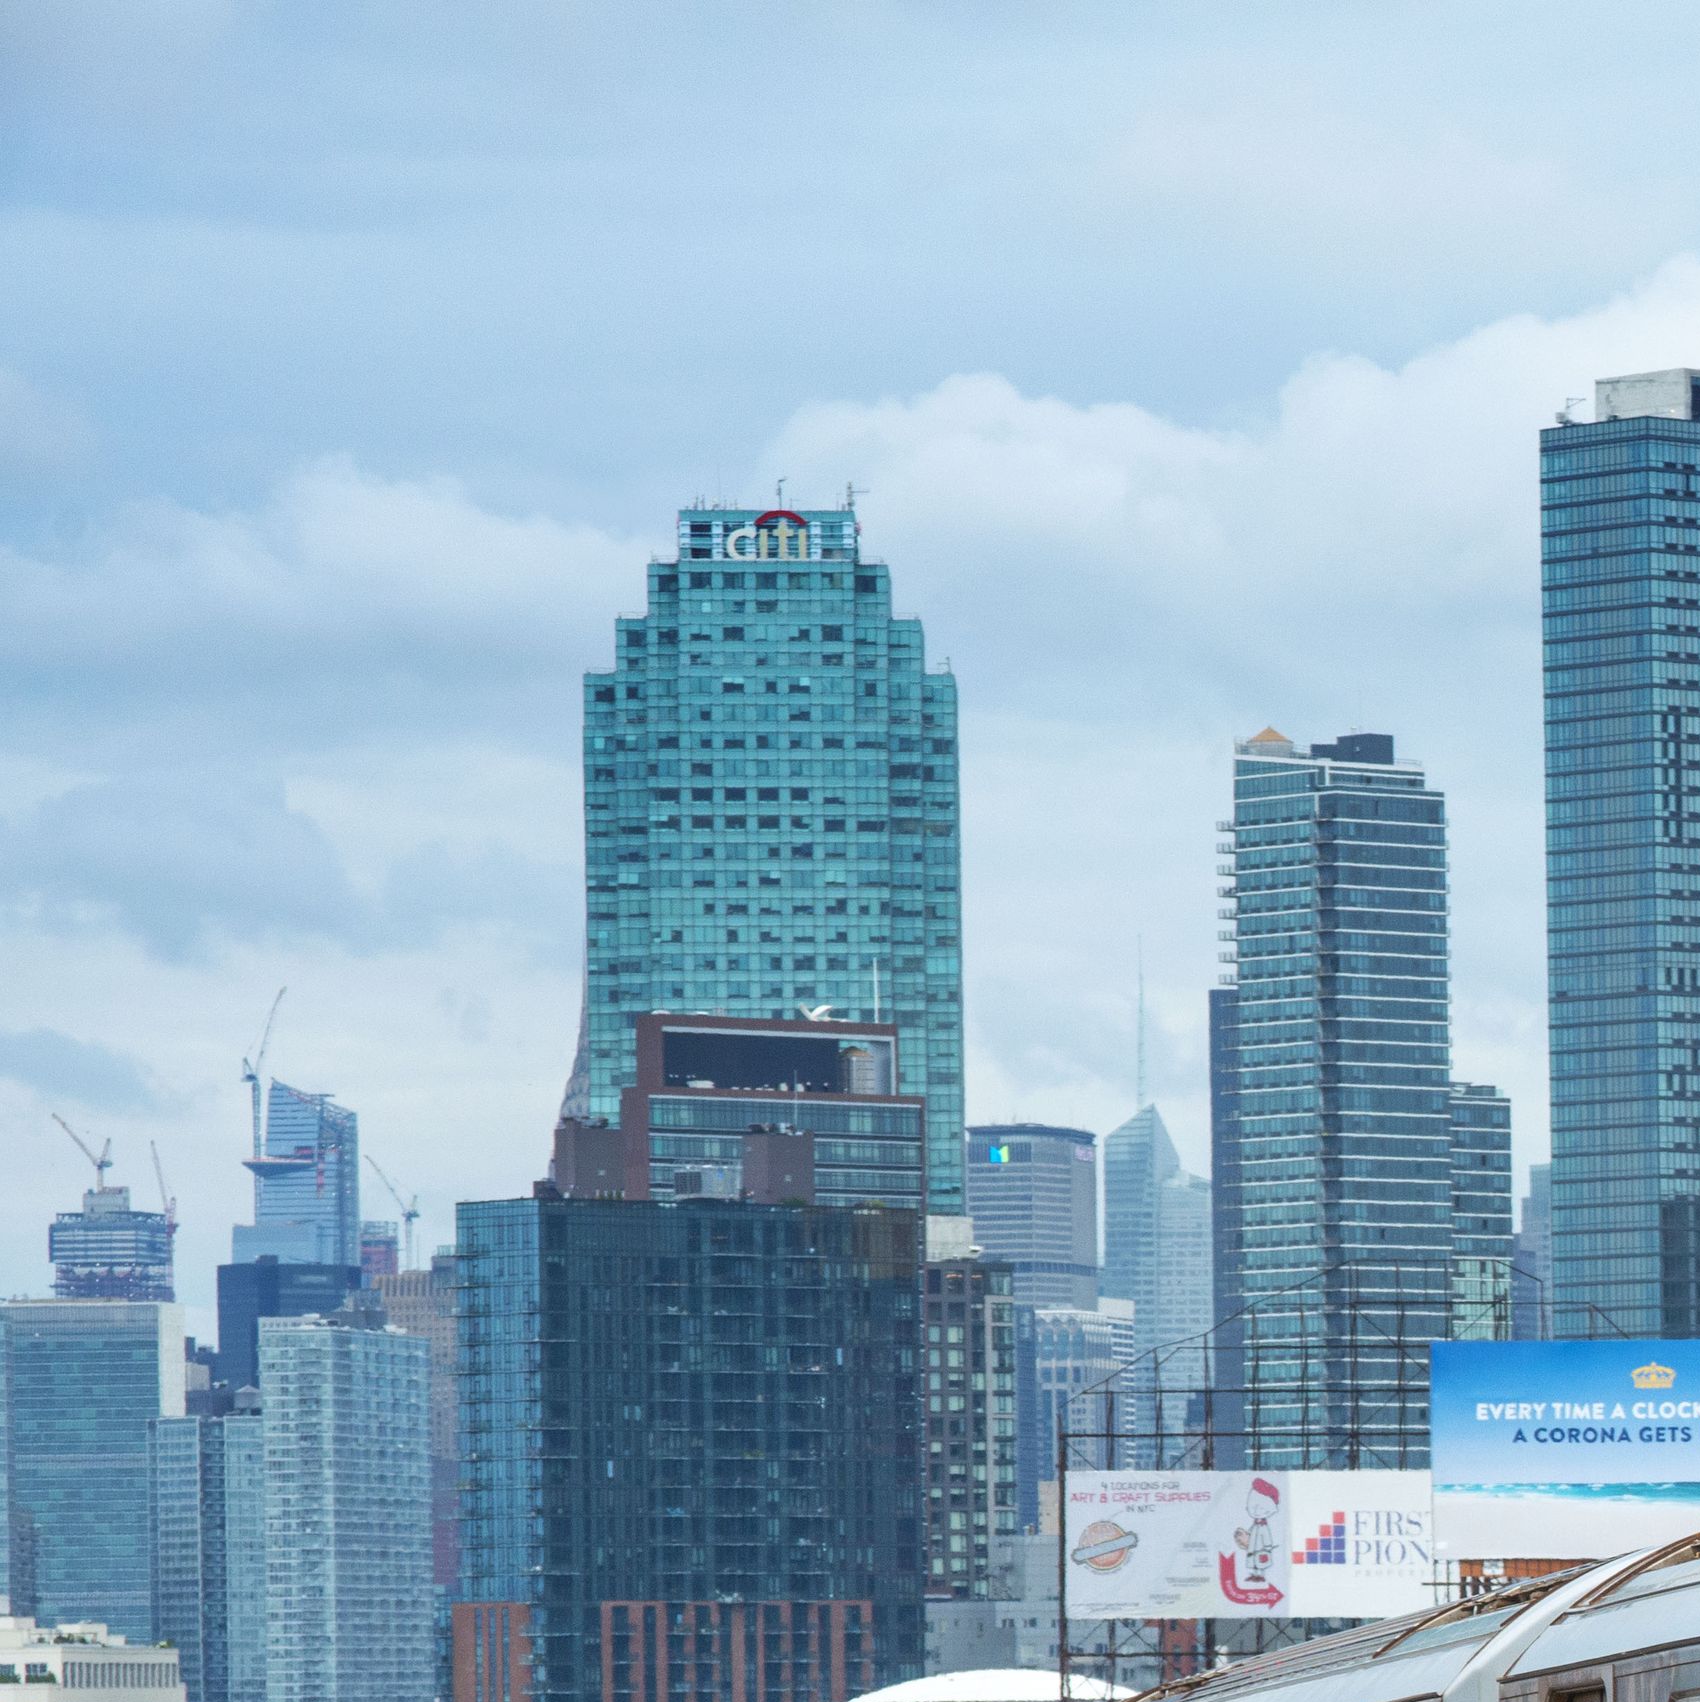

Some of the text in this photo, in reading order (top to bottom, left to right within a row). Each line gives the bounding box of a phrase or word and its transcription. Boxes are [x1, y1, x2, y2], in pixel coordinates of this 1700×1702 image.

[726, 518, 808, 560] citi
[1476, 1403, 1547, 1421] EVERY
[1551, 1403, 1605, 1419] TIME
[1611, 1403, 1626, 1419] A
[1512, 1428, 1527, 1443] A
[1534, 1428, 1632, 1443] CORONA
[1639, 1427, 1692, 1442] GETS
[1110, 1481, 1159, 1490] LOCATIONS
[1070, 1493, 1096, 1503] ART
[1112, 1492, 1150, 1503] CRAFT
[1155, 1492, 1211, 1502] SUPPLIES
